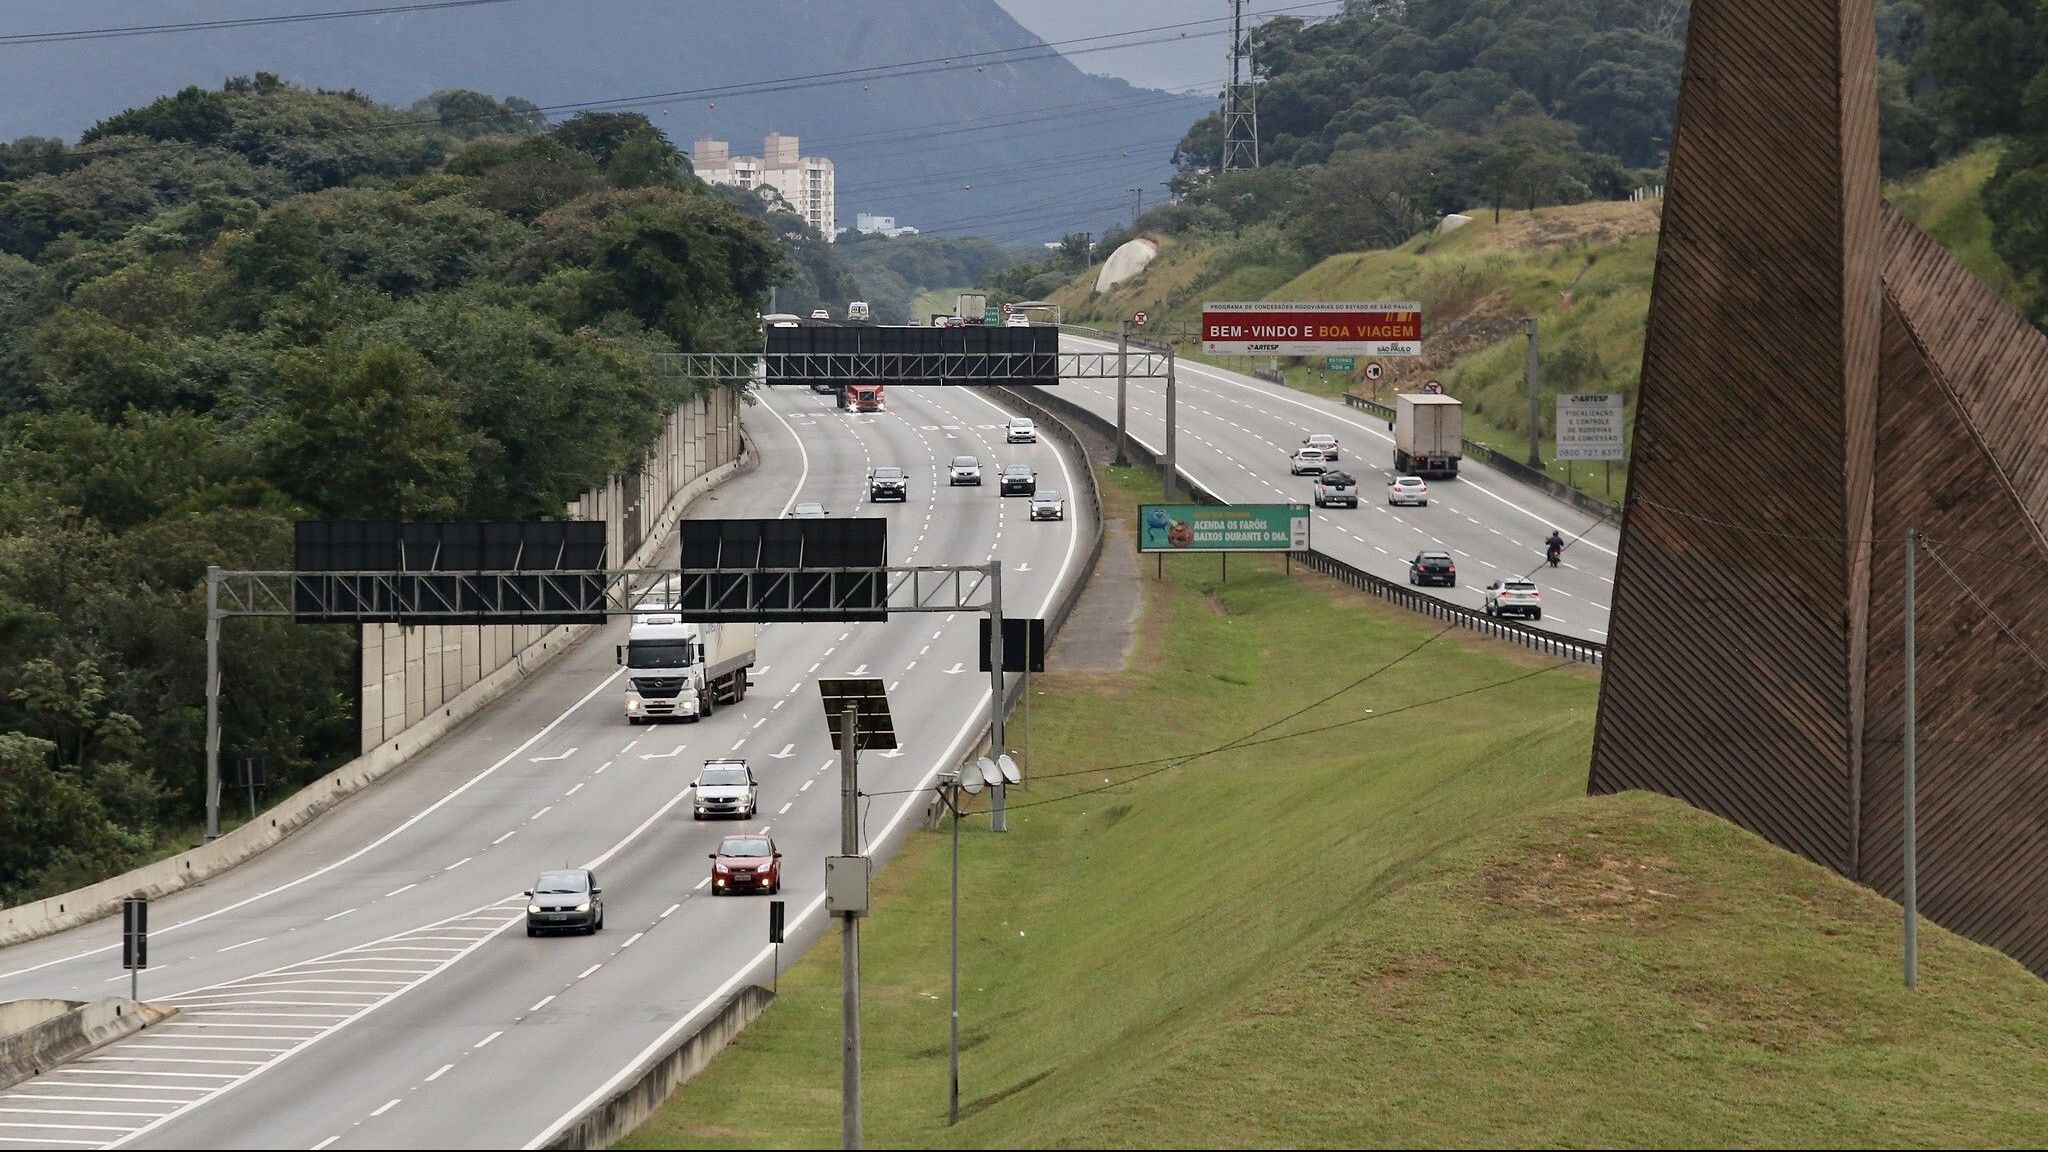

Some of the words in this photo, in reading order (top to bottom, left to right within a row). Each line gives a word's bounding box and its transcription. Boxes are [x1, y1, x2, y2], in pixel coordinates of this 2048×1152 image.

[1210, 325, 1298, 337] BEM-VINDO
[1304, 325, 1313, 337] E
[1319, 325, 1350, 337] BOA
[1357, 325, 1414, 337] VIAGEM
[1194, 521, 1225, 530] ACENDA
[1227, 521, 1238, 530] OS
[1239, 518, 1267, 530] FARÓIS
[1194, 532, 1223, 541] BAIXOS
[1225, 532, 1262, 541] DURANTE
[1263, 532, 1270, 541] O
